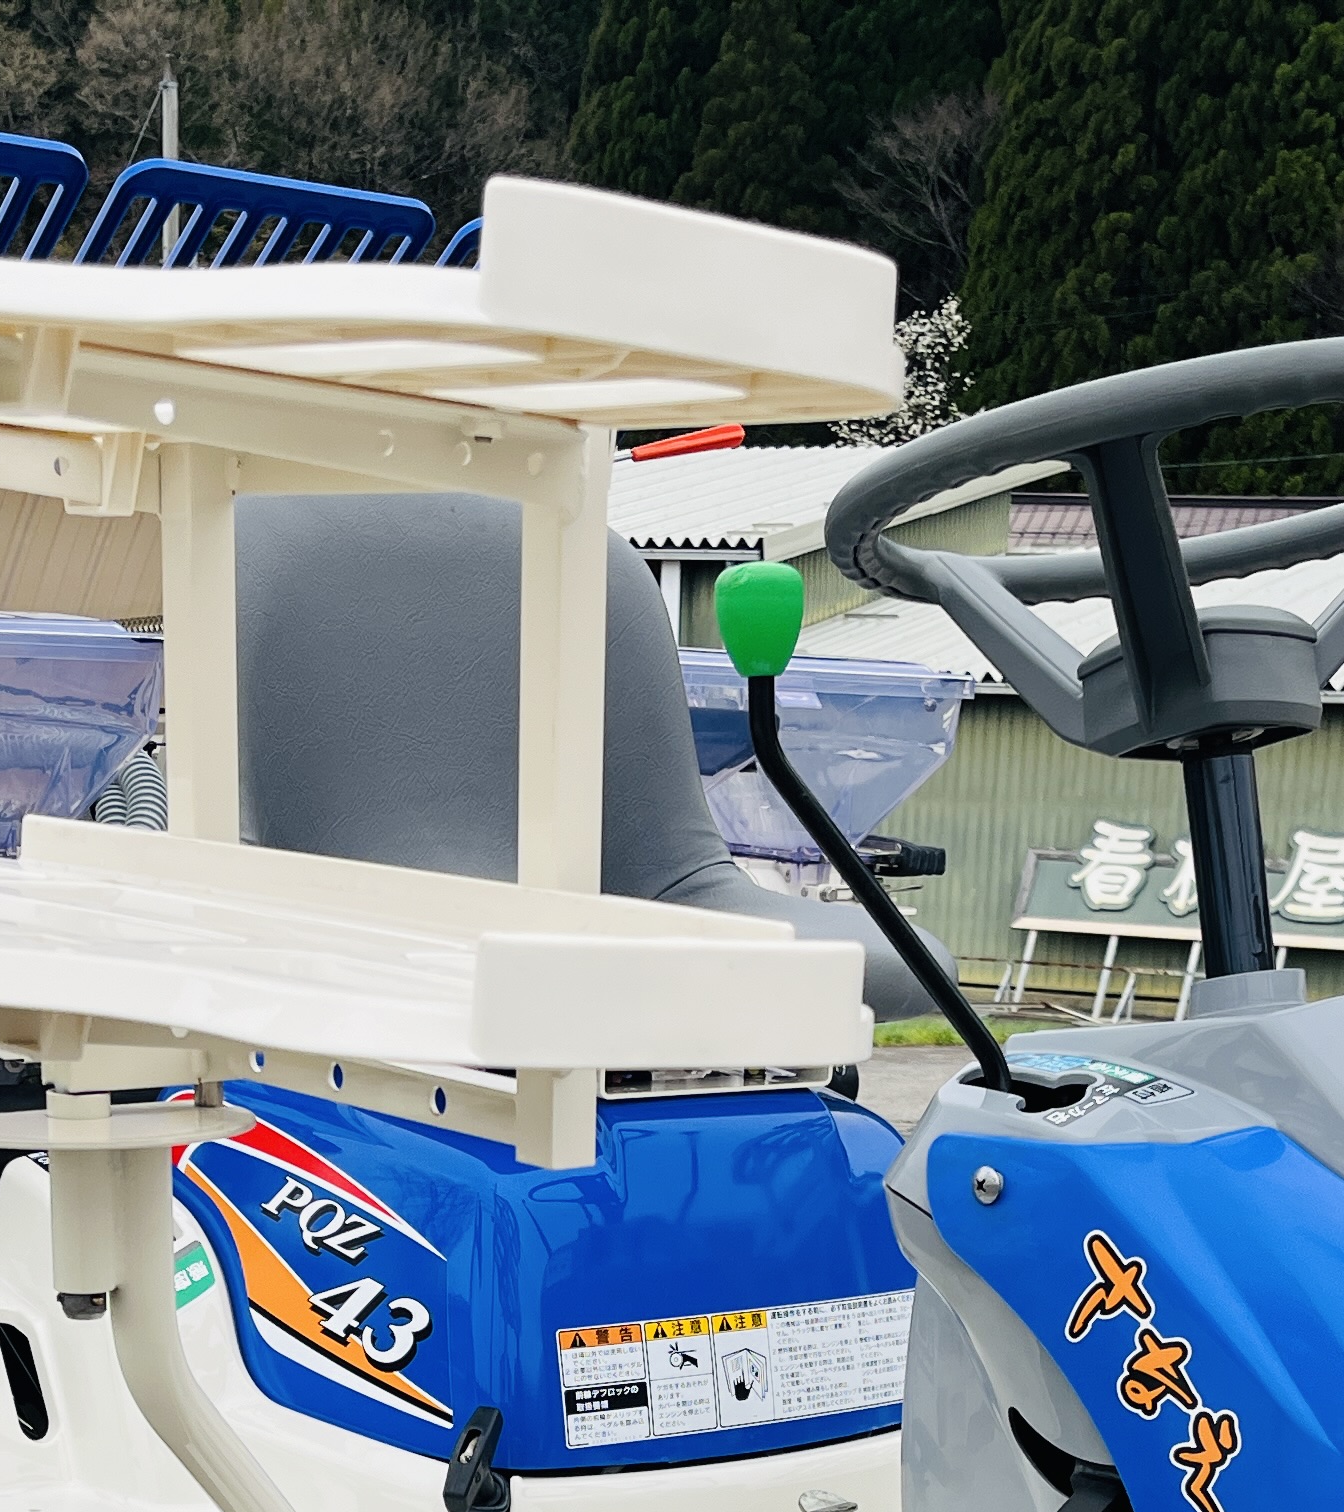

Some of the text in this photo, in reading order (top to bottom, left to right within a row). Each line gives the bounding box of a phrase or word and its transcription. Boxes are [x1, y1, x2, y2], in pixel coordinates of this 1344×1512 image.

[261, 1176, 384, 1265] PQZ
[308, 1275, 434, 1372] 43
[672, 1320, 702, 1336] 注意
[735, 1313, 763, 1330] 注意
[595, 1327, 634, 1345] 警告
